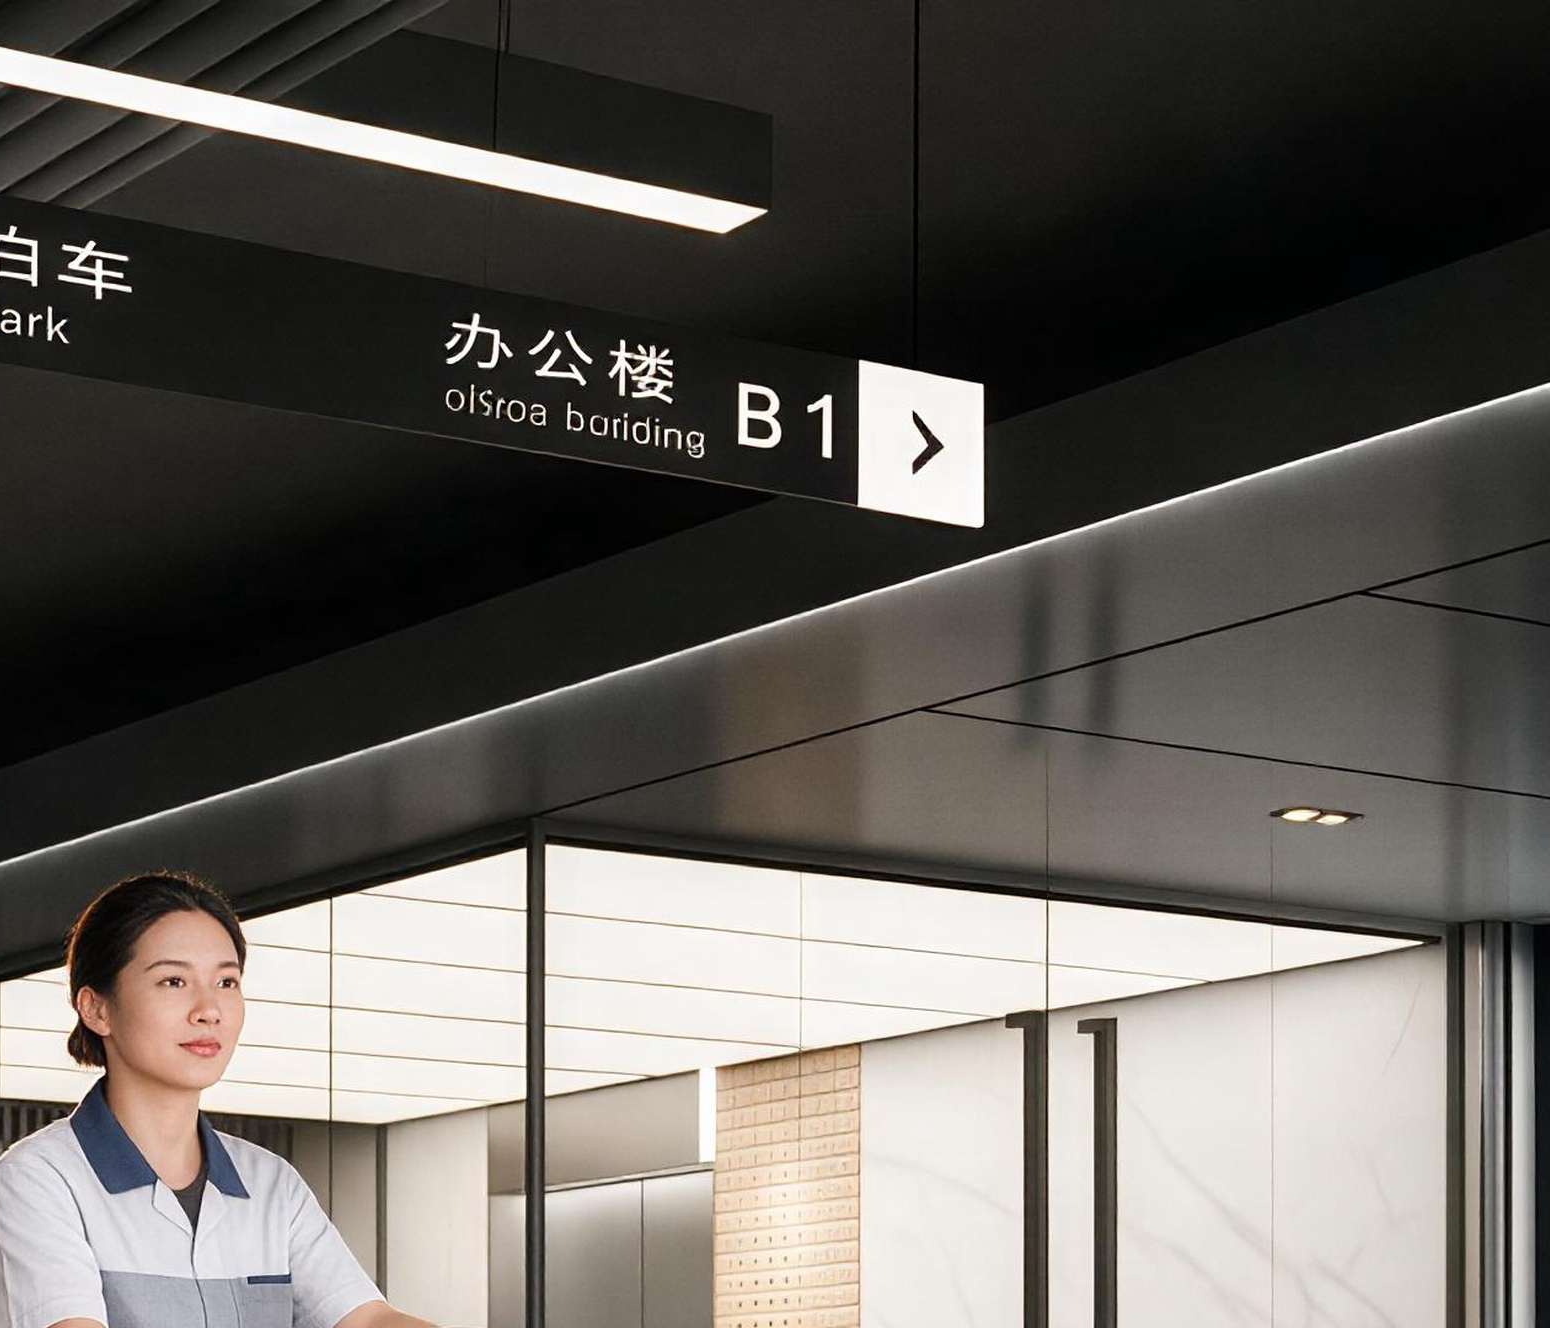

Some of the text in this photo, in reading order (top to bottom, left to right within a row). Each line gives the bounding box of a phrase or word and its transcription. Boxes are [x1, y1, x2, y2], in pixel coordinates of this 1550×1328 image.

[444, 312, 674, 404] 办公楼
[737, 381, 833, 459] B1
